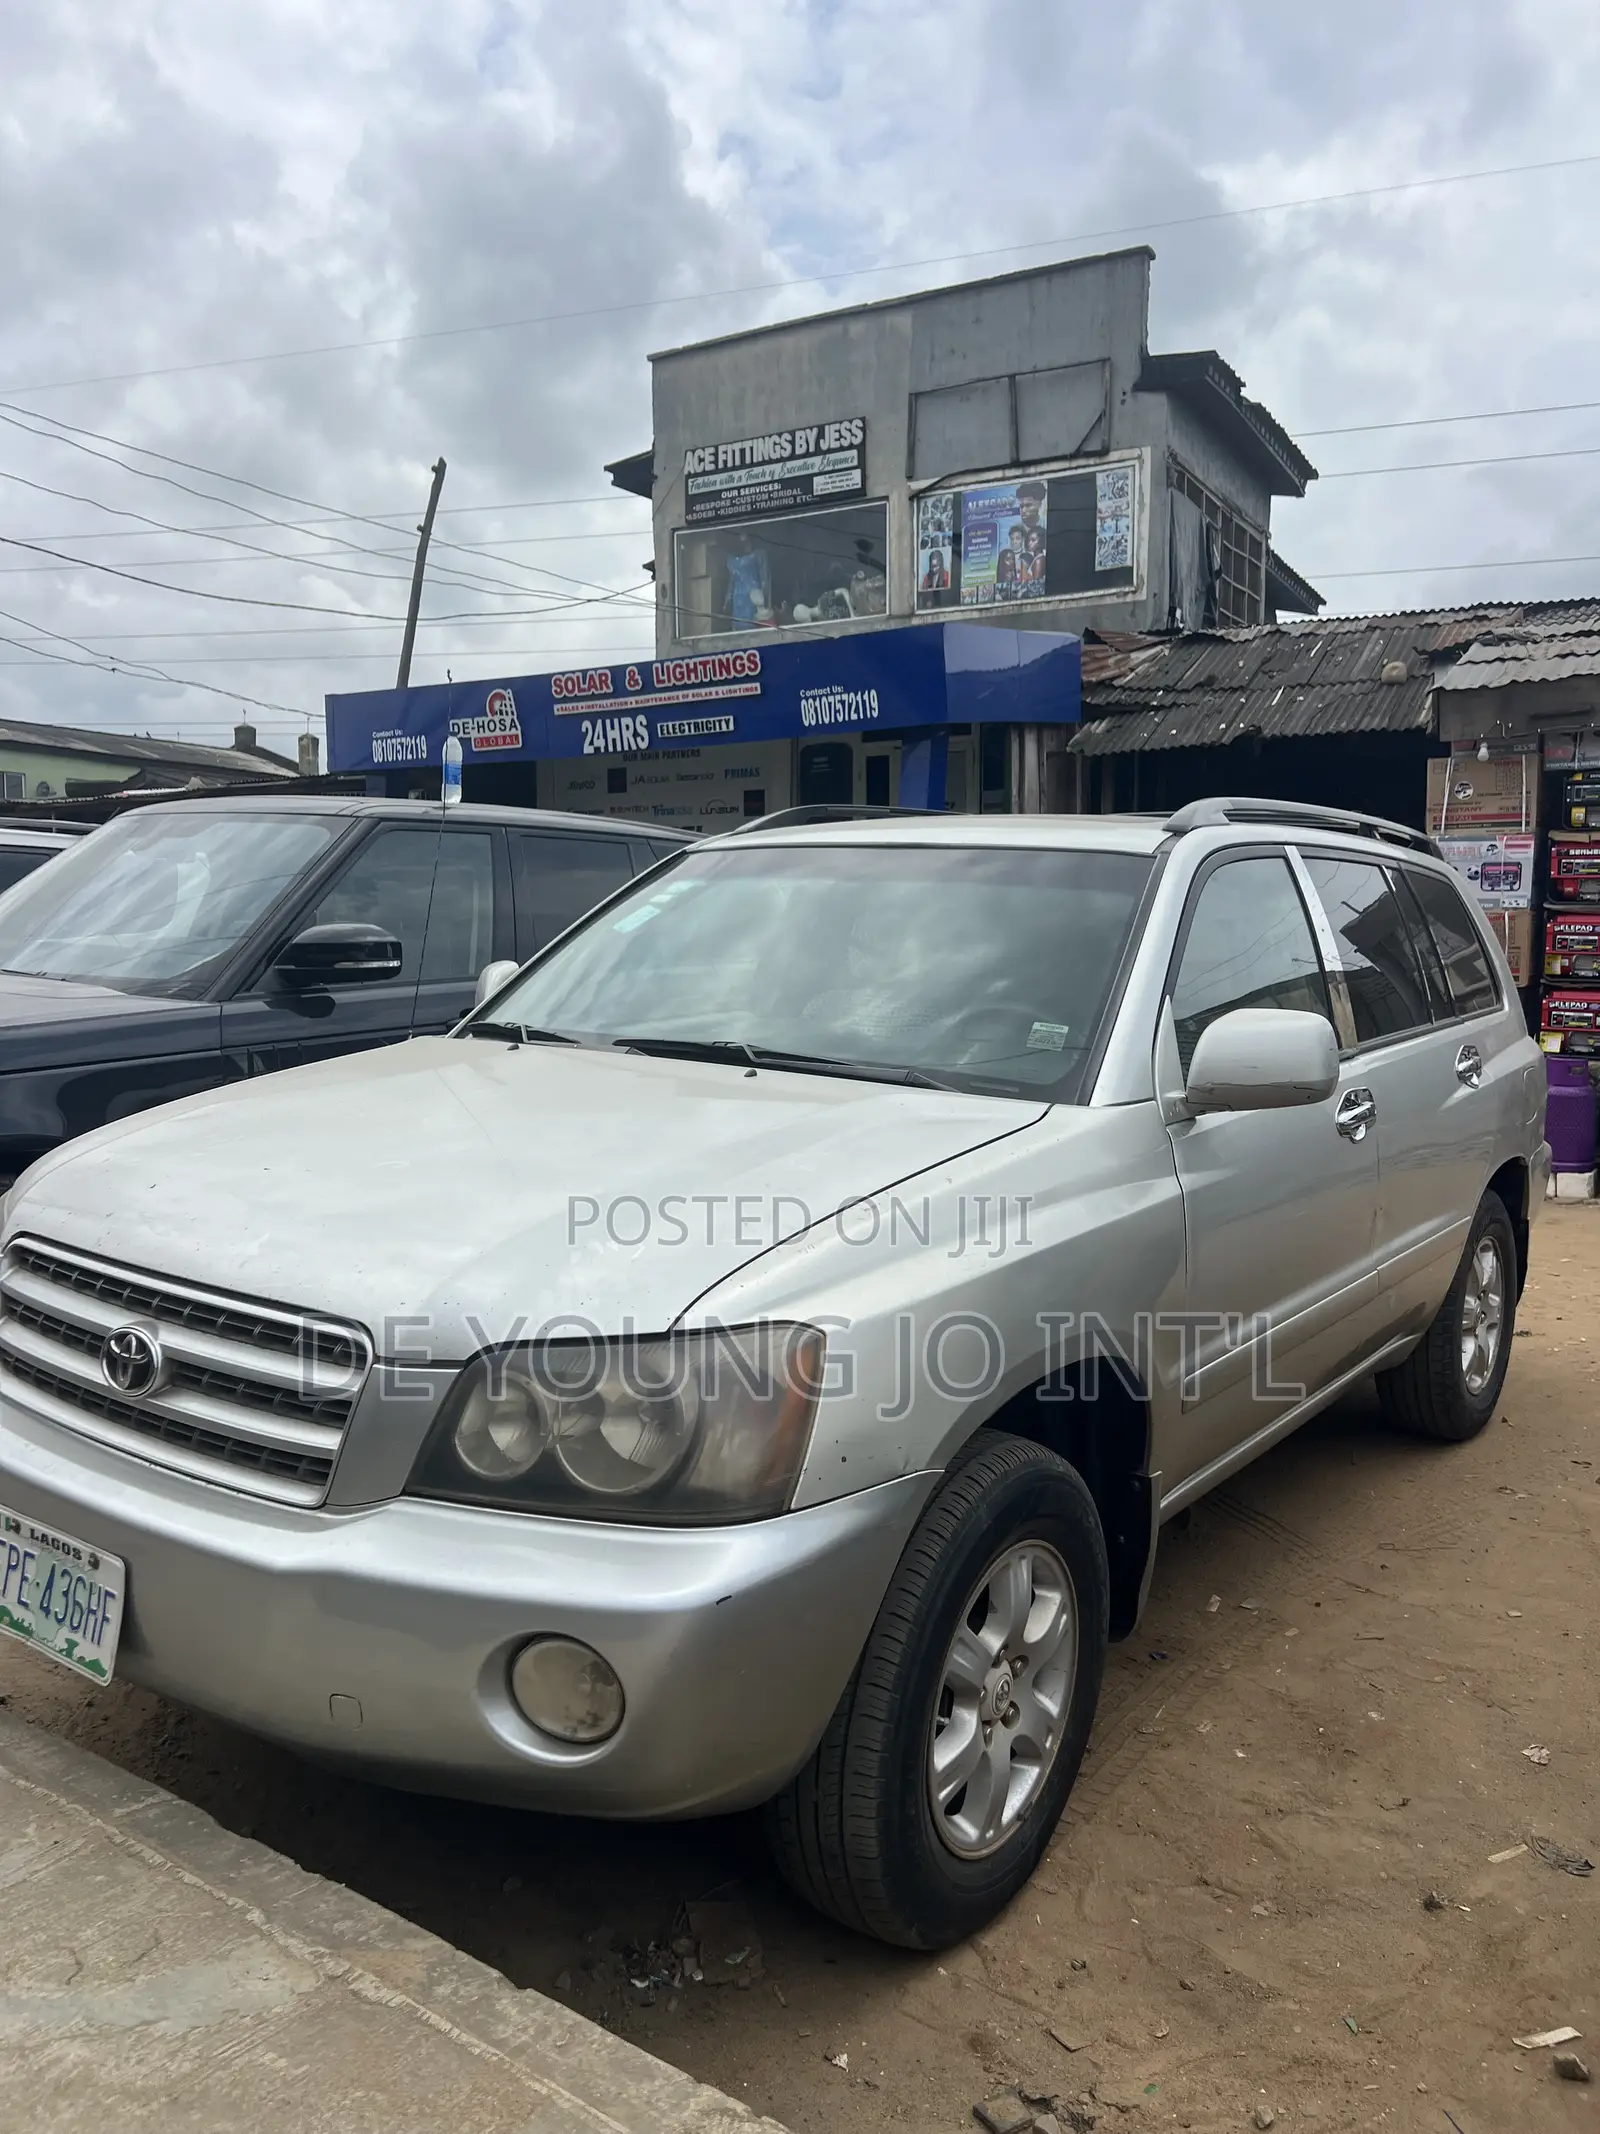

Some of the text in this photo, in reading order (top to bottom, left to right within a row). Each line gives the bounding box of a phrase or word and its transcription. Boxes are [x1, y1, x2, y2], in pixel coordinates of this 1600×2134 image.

[684, 418, 864, 475] ACE FITTINGS BY JESS
[778, 461, 816, 478] Executive
[818, 455, 855, 471] Elegance
[721, 489, 739, 498] OUR
[552, 650, 761, 699] SOLAR & LIGHTINGS
[585, 701, 629, 711] INSTALLATION
[691, 691, 713, 699] SOLAR
[721, 686, 759, 696] LIGHTINGS
[800, 685, 844, 698] Contact Us:
[800, 688, 878, 727] 08107572119
[372, 730, 394, 739] Contact
[451, 718, 519, 737] DE-HOSA
[581, 714, 732, 754] 24HRS ELECTRICITY
[372, 735, 427, 763] 08107572119
[474, 735, 520, 748] GLOBAL
[623, 748, 701, 763] OUR MAIN PARTNERS
[30, 1528, 82, 1561] LAGOS
[0, 1538, 117, 1647] PE-436HF
